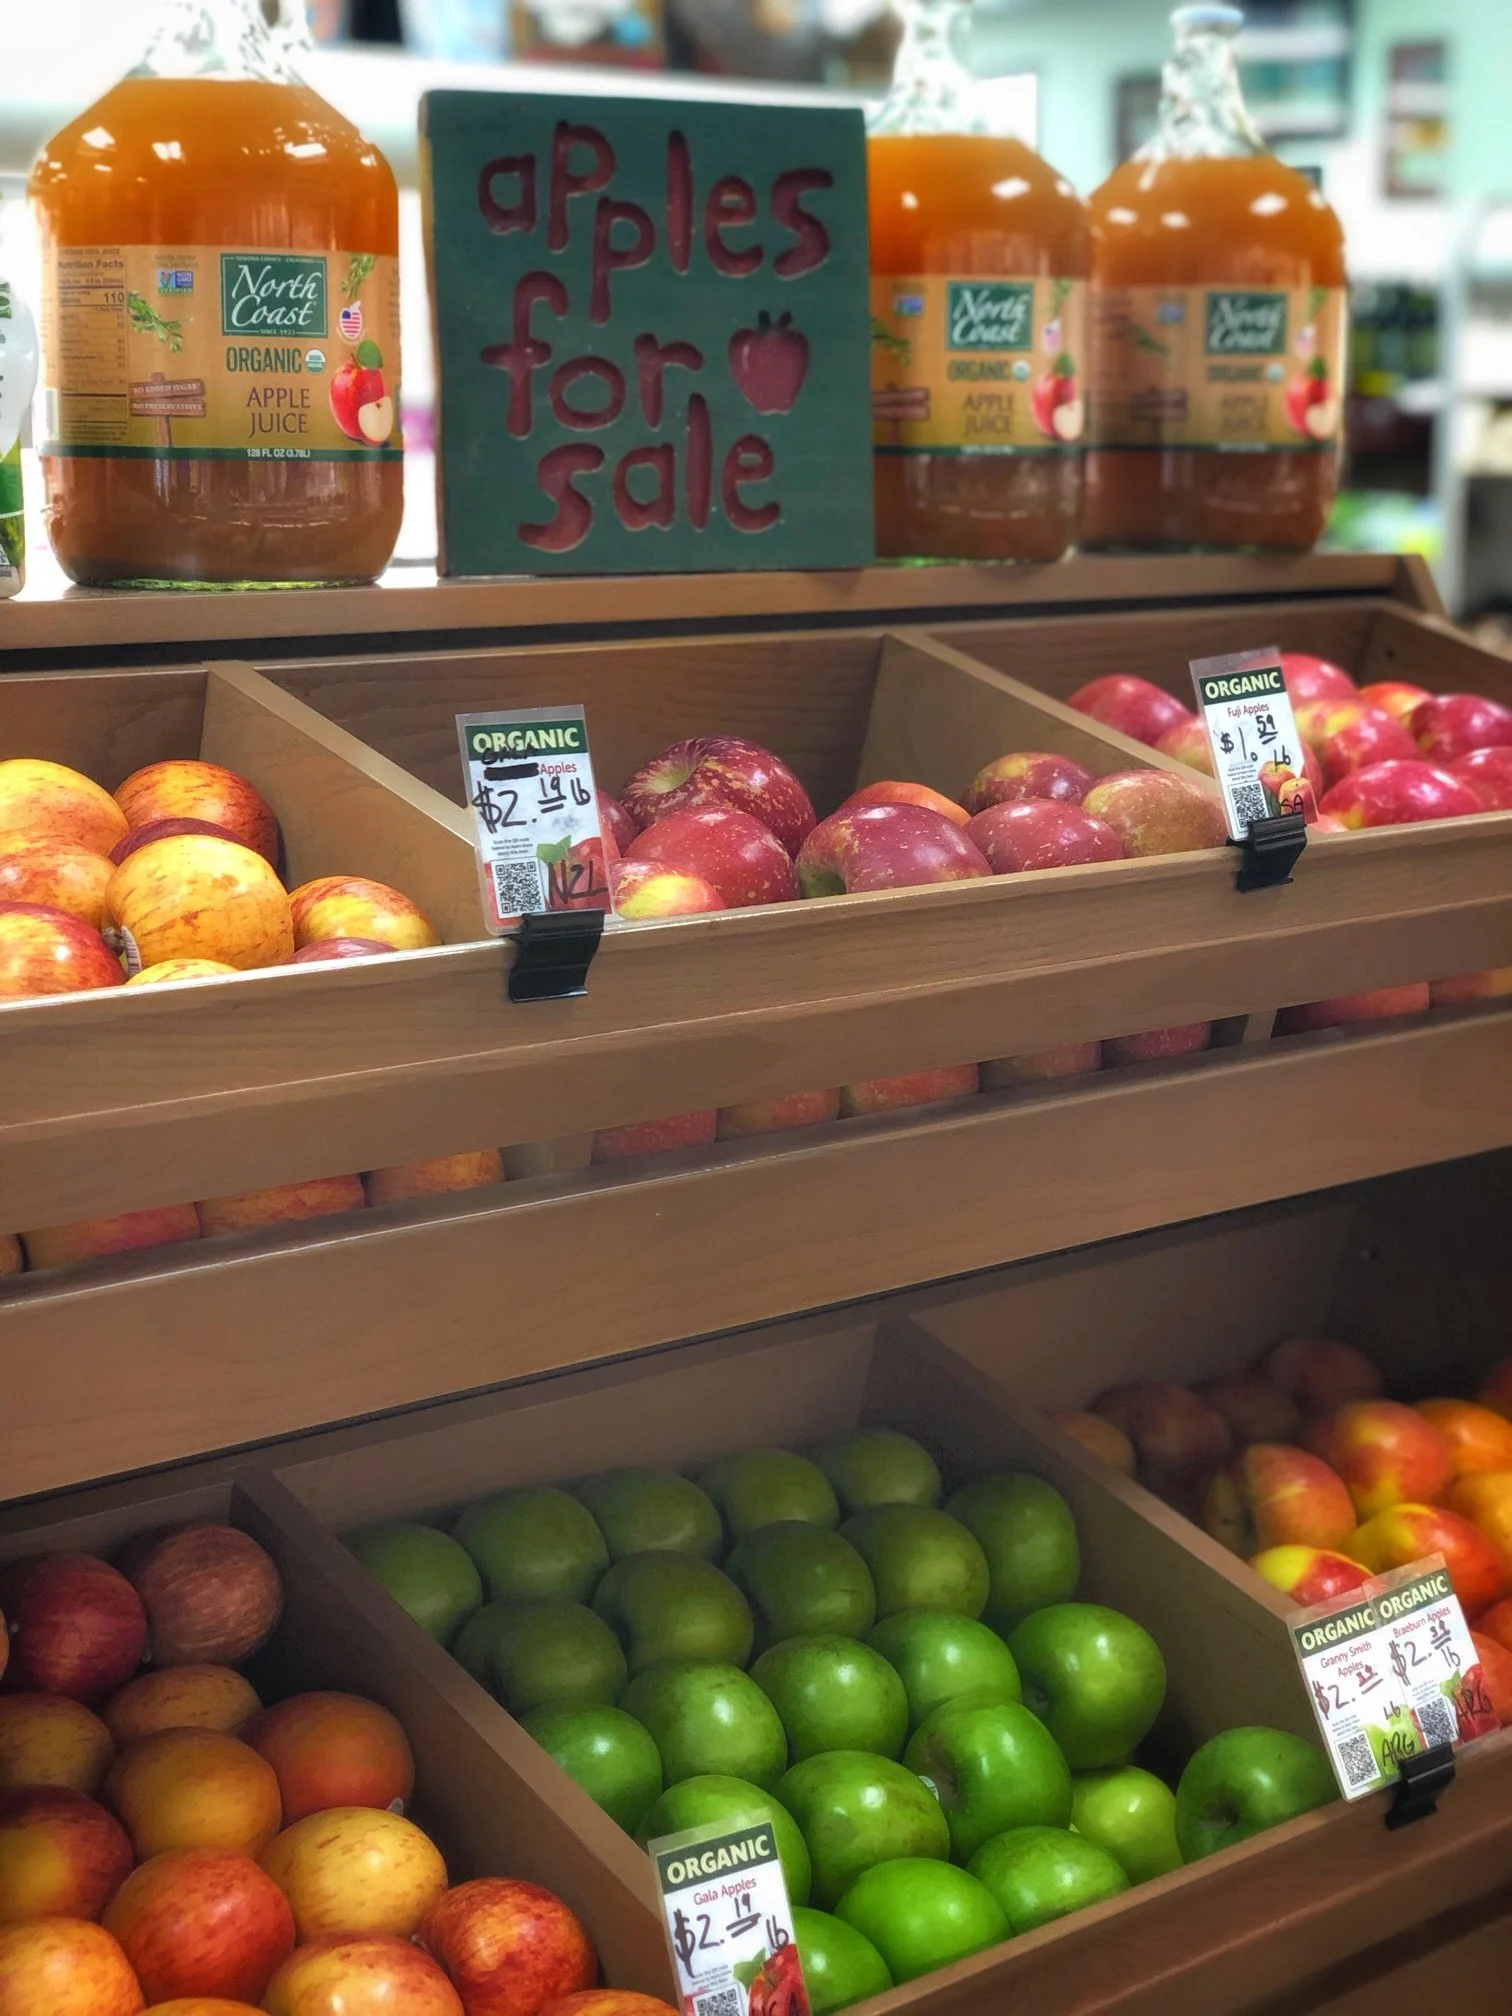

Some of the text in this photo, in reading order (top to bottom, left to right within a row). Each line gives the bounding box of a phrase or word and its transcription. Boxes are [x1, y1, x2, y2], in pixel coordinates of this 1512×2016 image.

[478, 120, 834, 325] apples
[95, 259, 124, 268] Facts
[231, 264, 322, 299] North
[104, 292, 125, 303] 110
[231, 294, 313, 327] Coast
[952, 289, 1031, 320] North
[226, 346, 302, 374] ORGANIC
[480, 270, 704, 439] for
[246, 386, 311, 408] APPLE
[963, 392, 1015, 411] APPLE
[248, 412, 309, 439] JUICE
[261, 448, 273, 458] FL
[274, 448, 285, 458] OZ
[517, 393, 781, 553] sale
[1205, 671, 1281, 699] ORGANIC
[1227, 702, 1270, 718] Fuji Apples
[473, 727, 580, 753] ORGANIC
[540, 760, 577, 777] Apples
[1379, 1575, 1448, 1619] ORGANIC
[1301, 1608, 1376, 1650] ORGANIC
[1392, 1606, 1451, 1639] Braeburn Apples
[1320, 1640, 1373, 1670] Granny Smith
[1337, 1661, 1365, 1678] Apples
[667, 1834, 771, 1884] ORGANIC
[693, 1876, 757, 1906] Gala Apples
